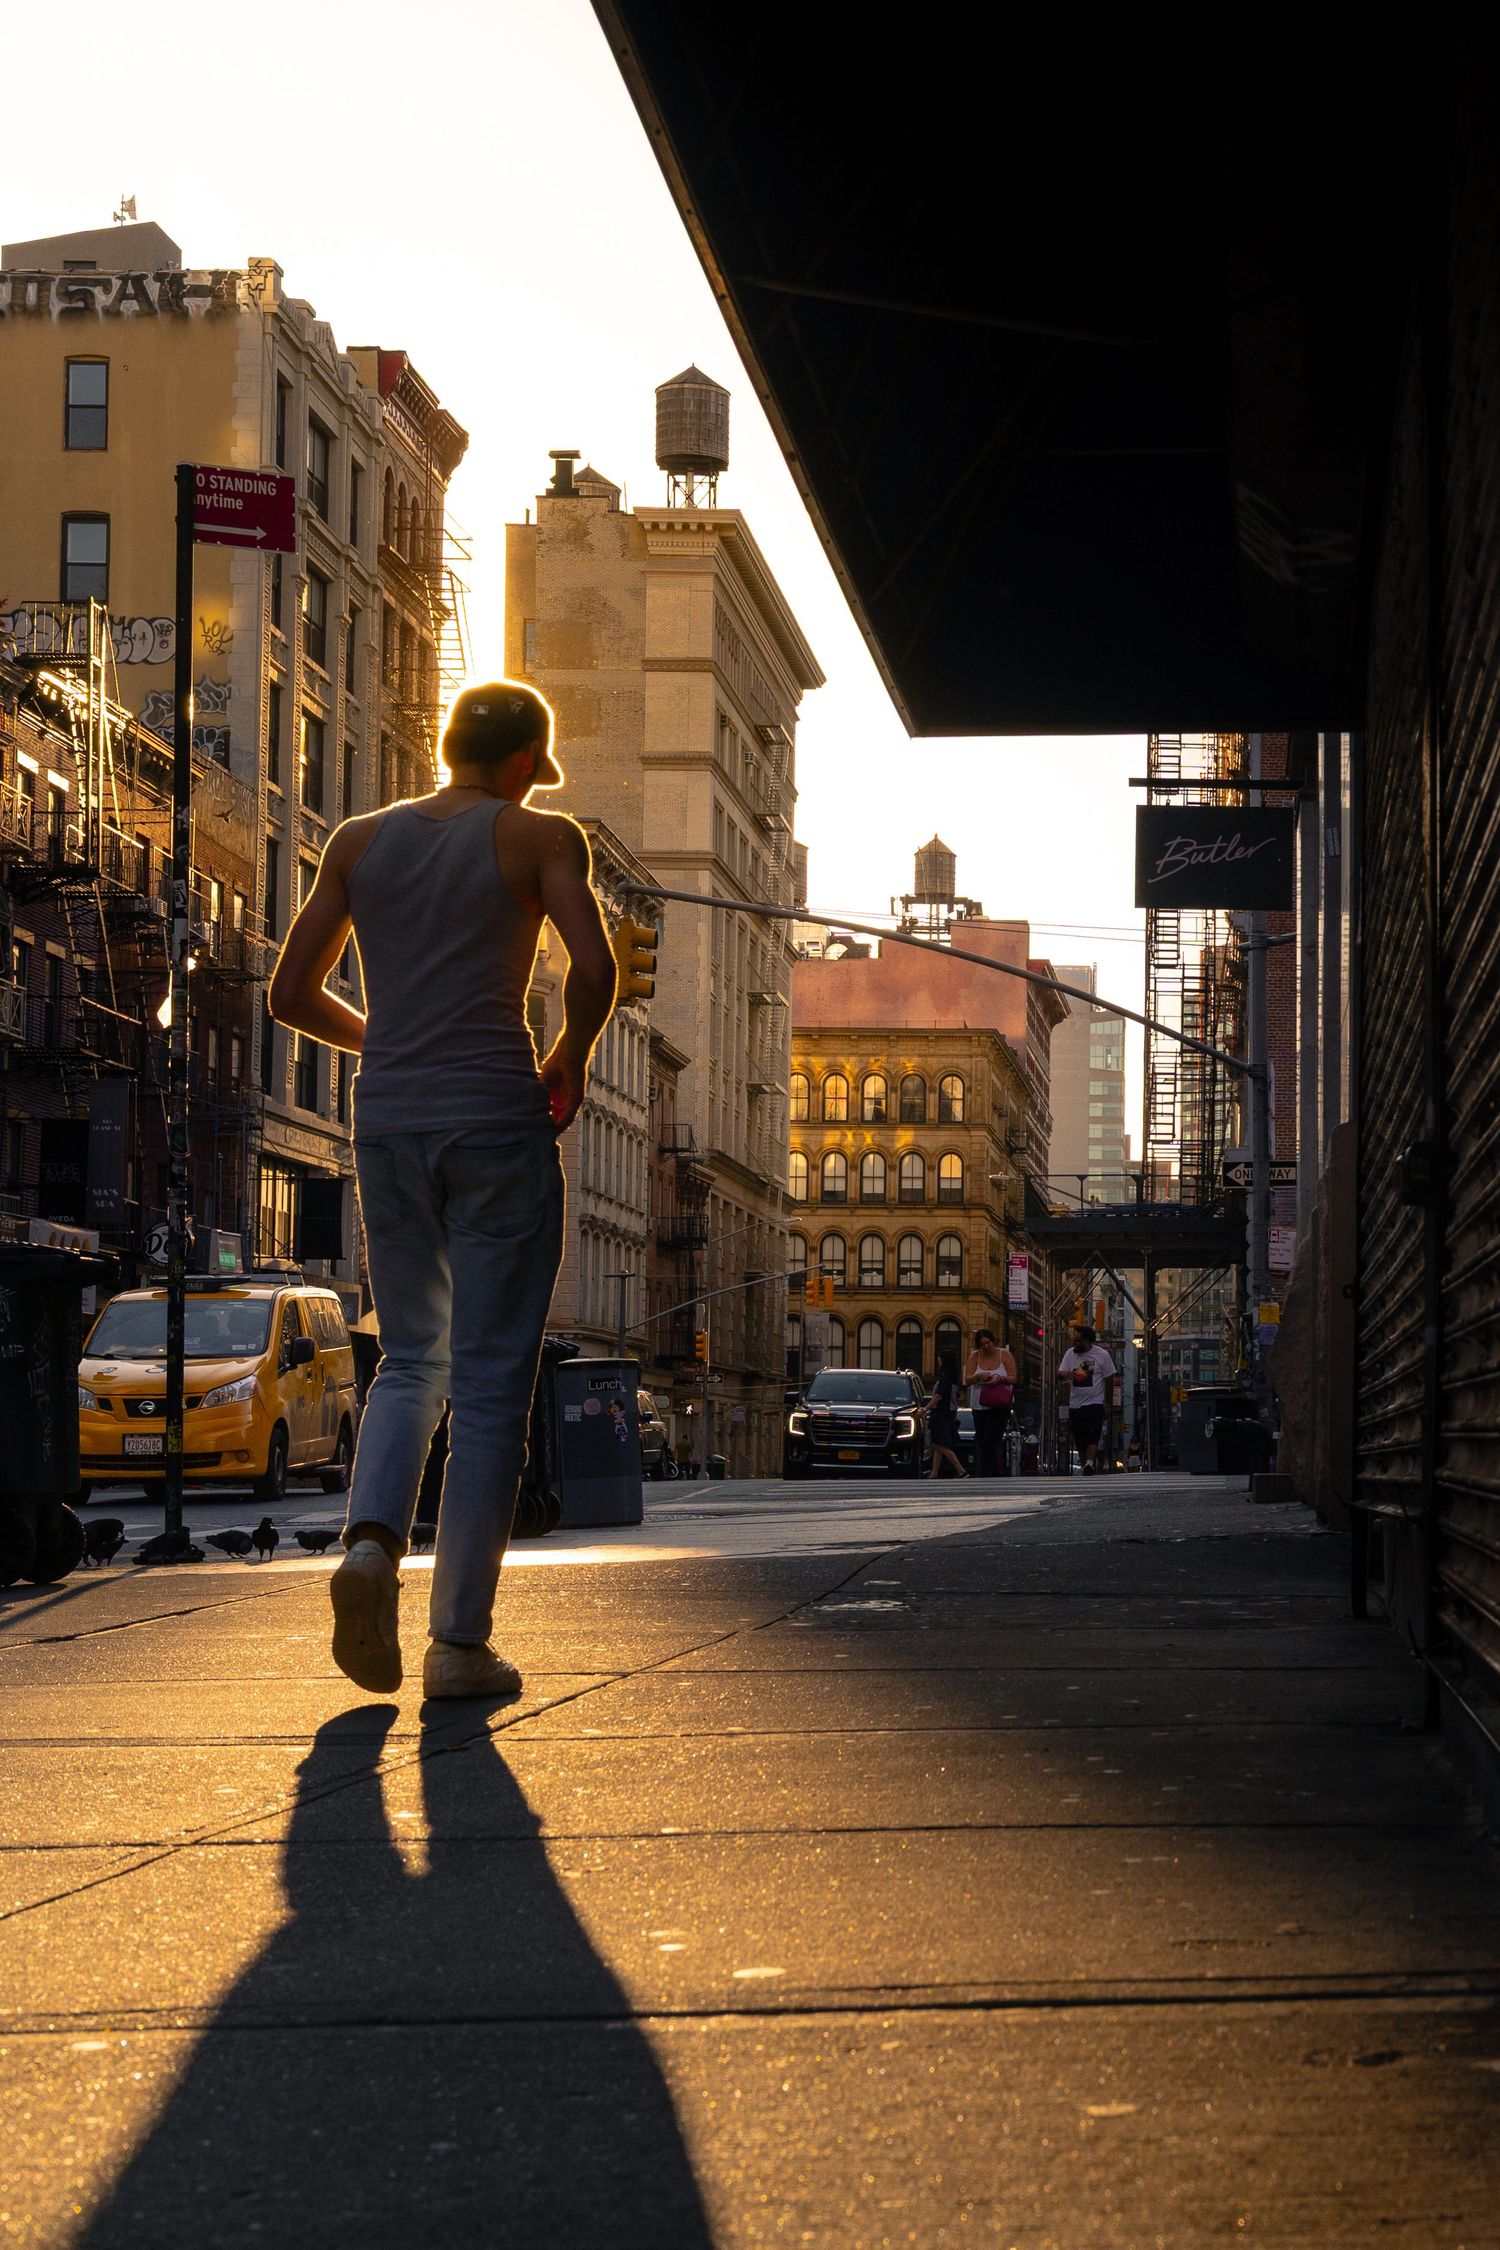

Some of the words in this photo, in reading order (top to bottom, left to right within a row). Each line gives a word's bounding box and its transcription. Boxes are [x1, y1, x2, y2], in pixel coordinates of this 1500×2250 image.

[209, 475, 277, 496] STANDING
[1146, 833, 1277, 884] Butler
[588, 1378, 622, 1391] Lunch
[127, 1439, 161, 1451] Y205618C
